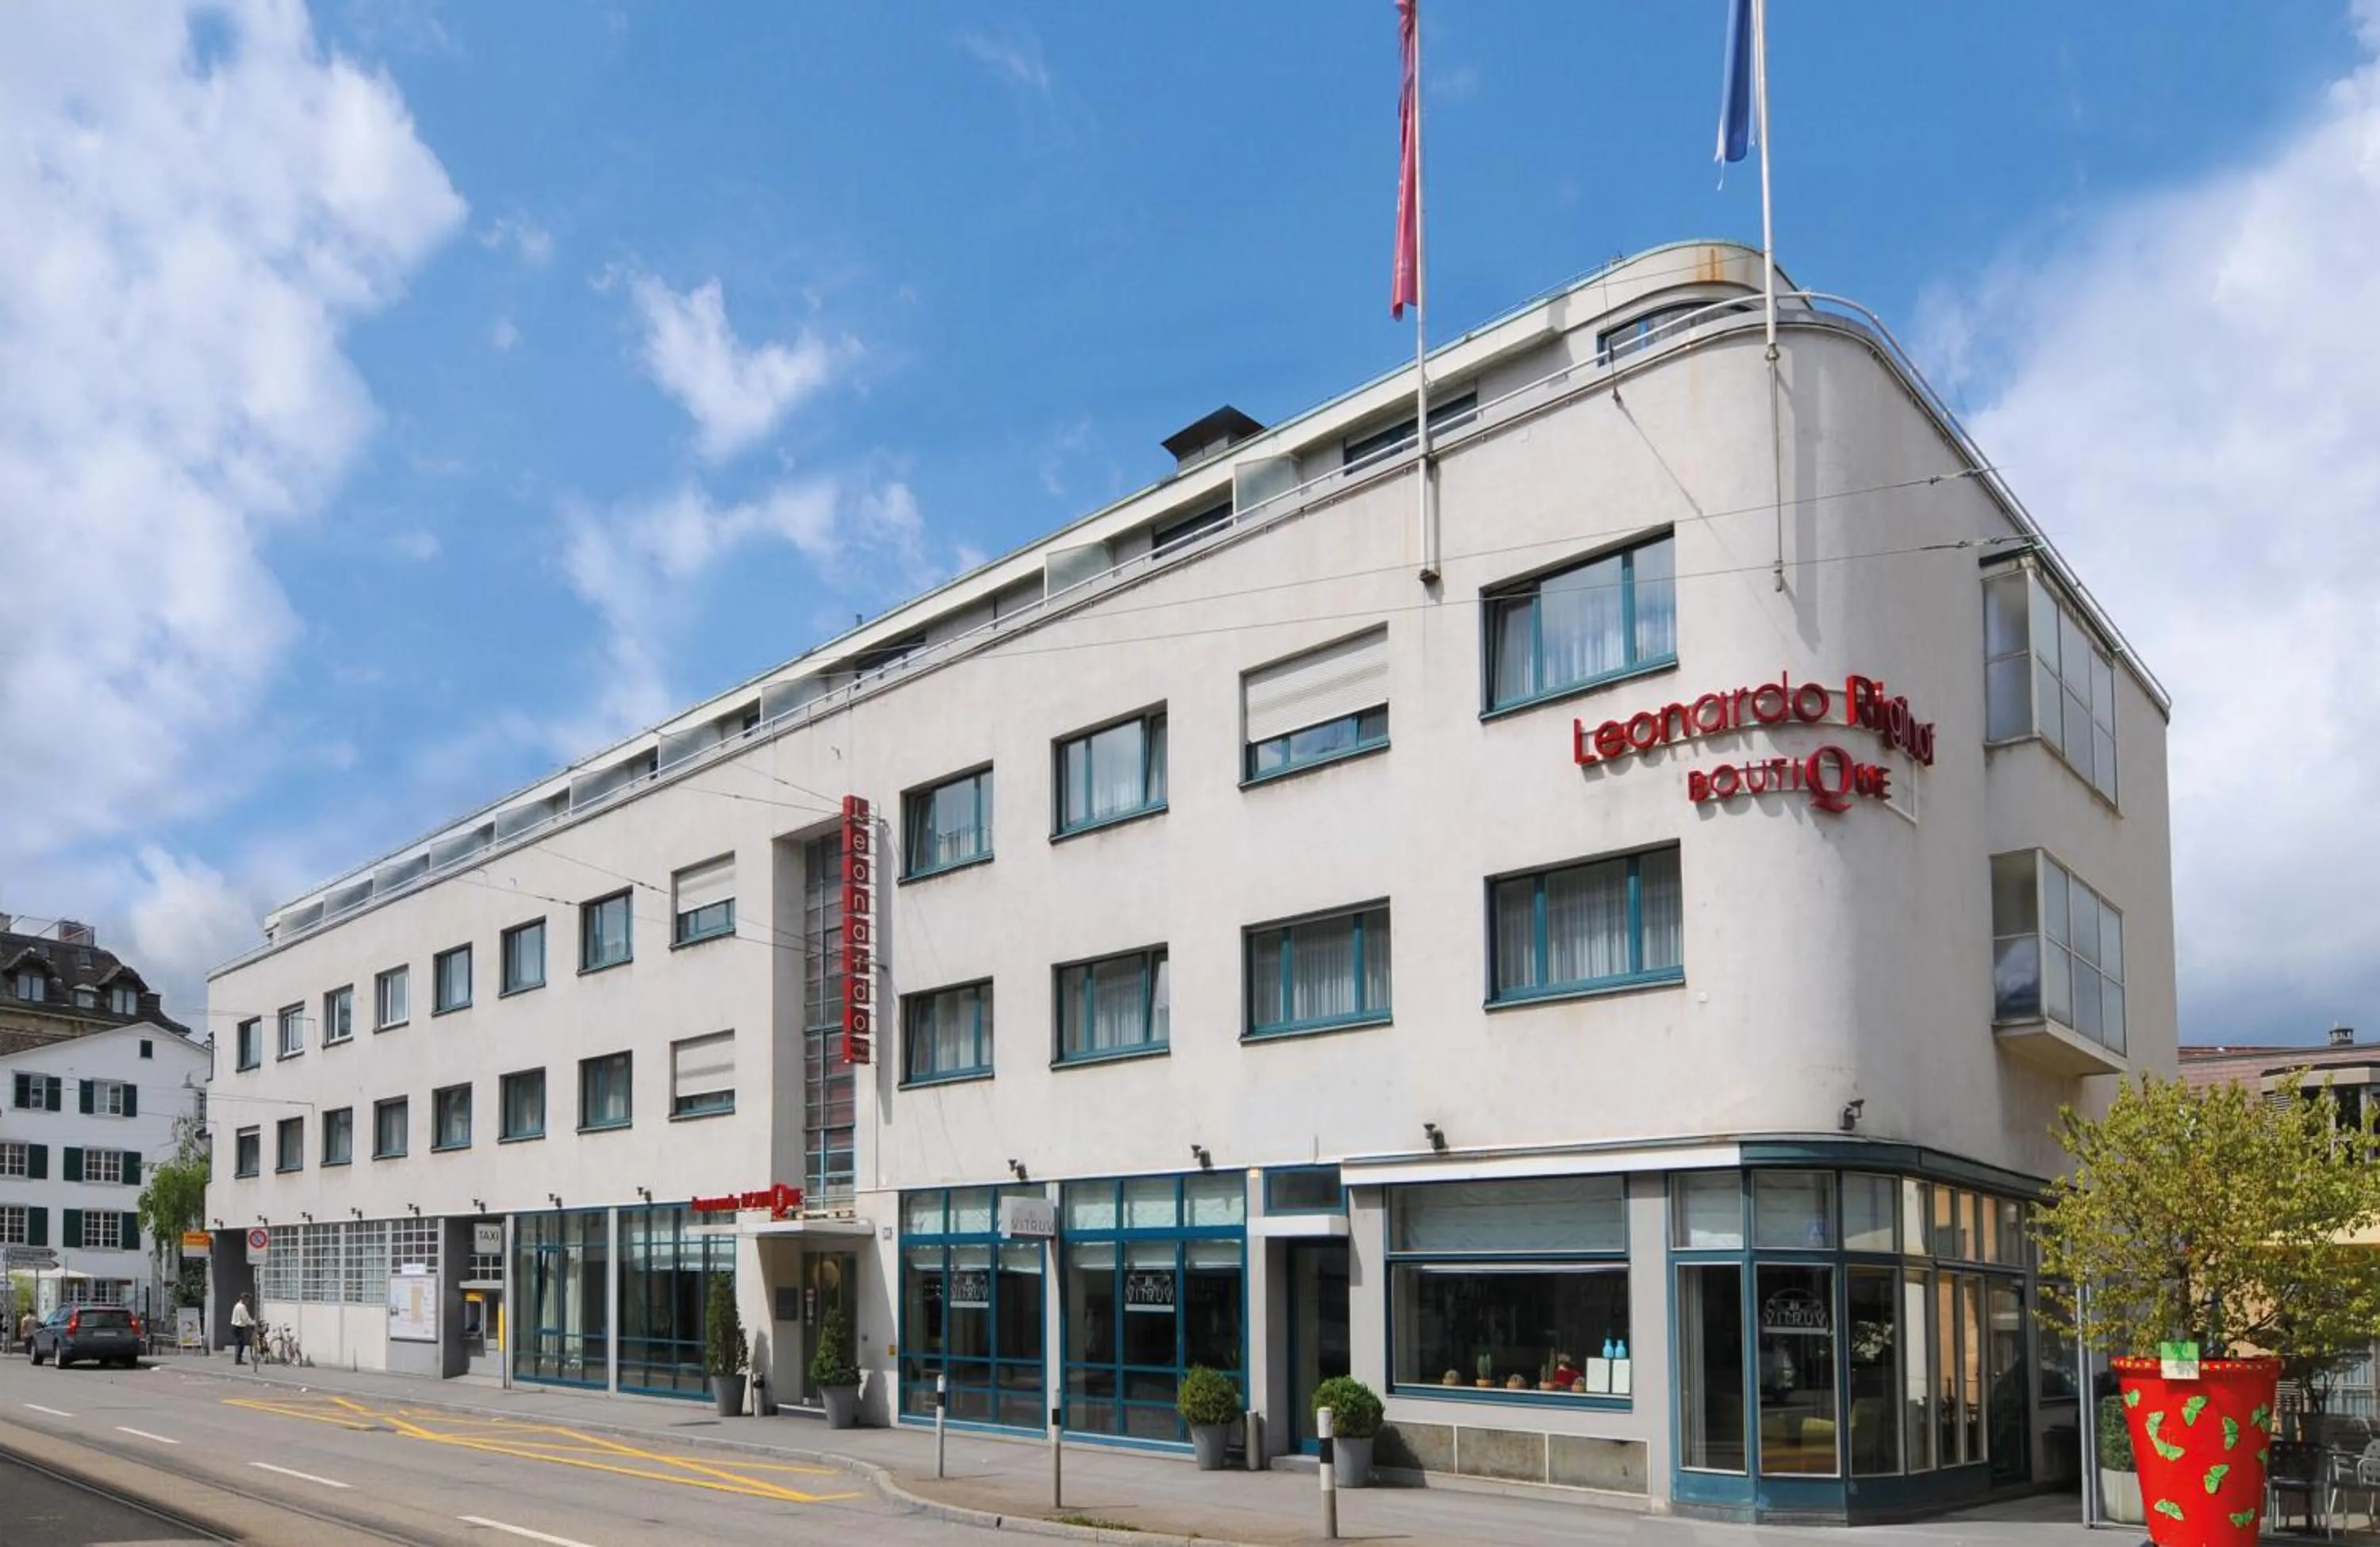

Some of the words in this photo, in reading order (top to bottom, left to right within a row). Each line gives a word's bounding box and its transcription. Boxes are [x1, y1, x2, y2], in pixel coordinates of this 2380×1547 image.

[1573, 670, 1829, 765] Leonardo
[1012, 1217, 1054, 1232] VITRUV
[478, 1230, 499, 1242] TAXI
[1764, 1311, 1827, 1327] VITRUV
